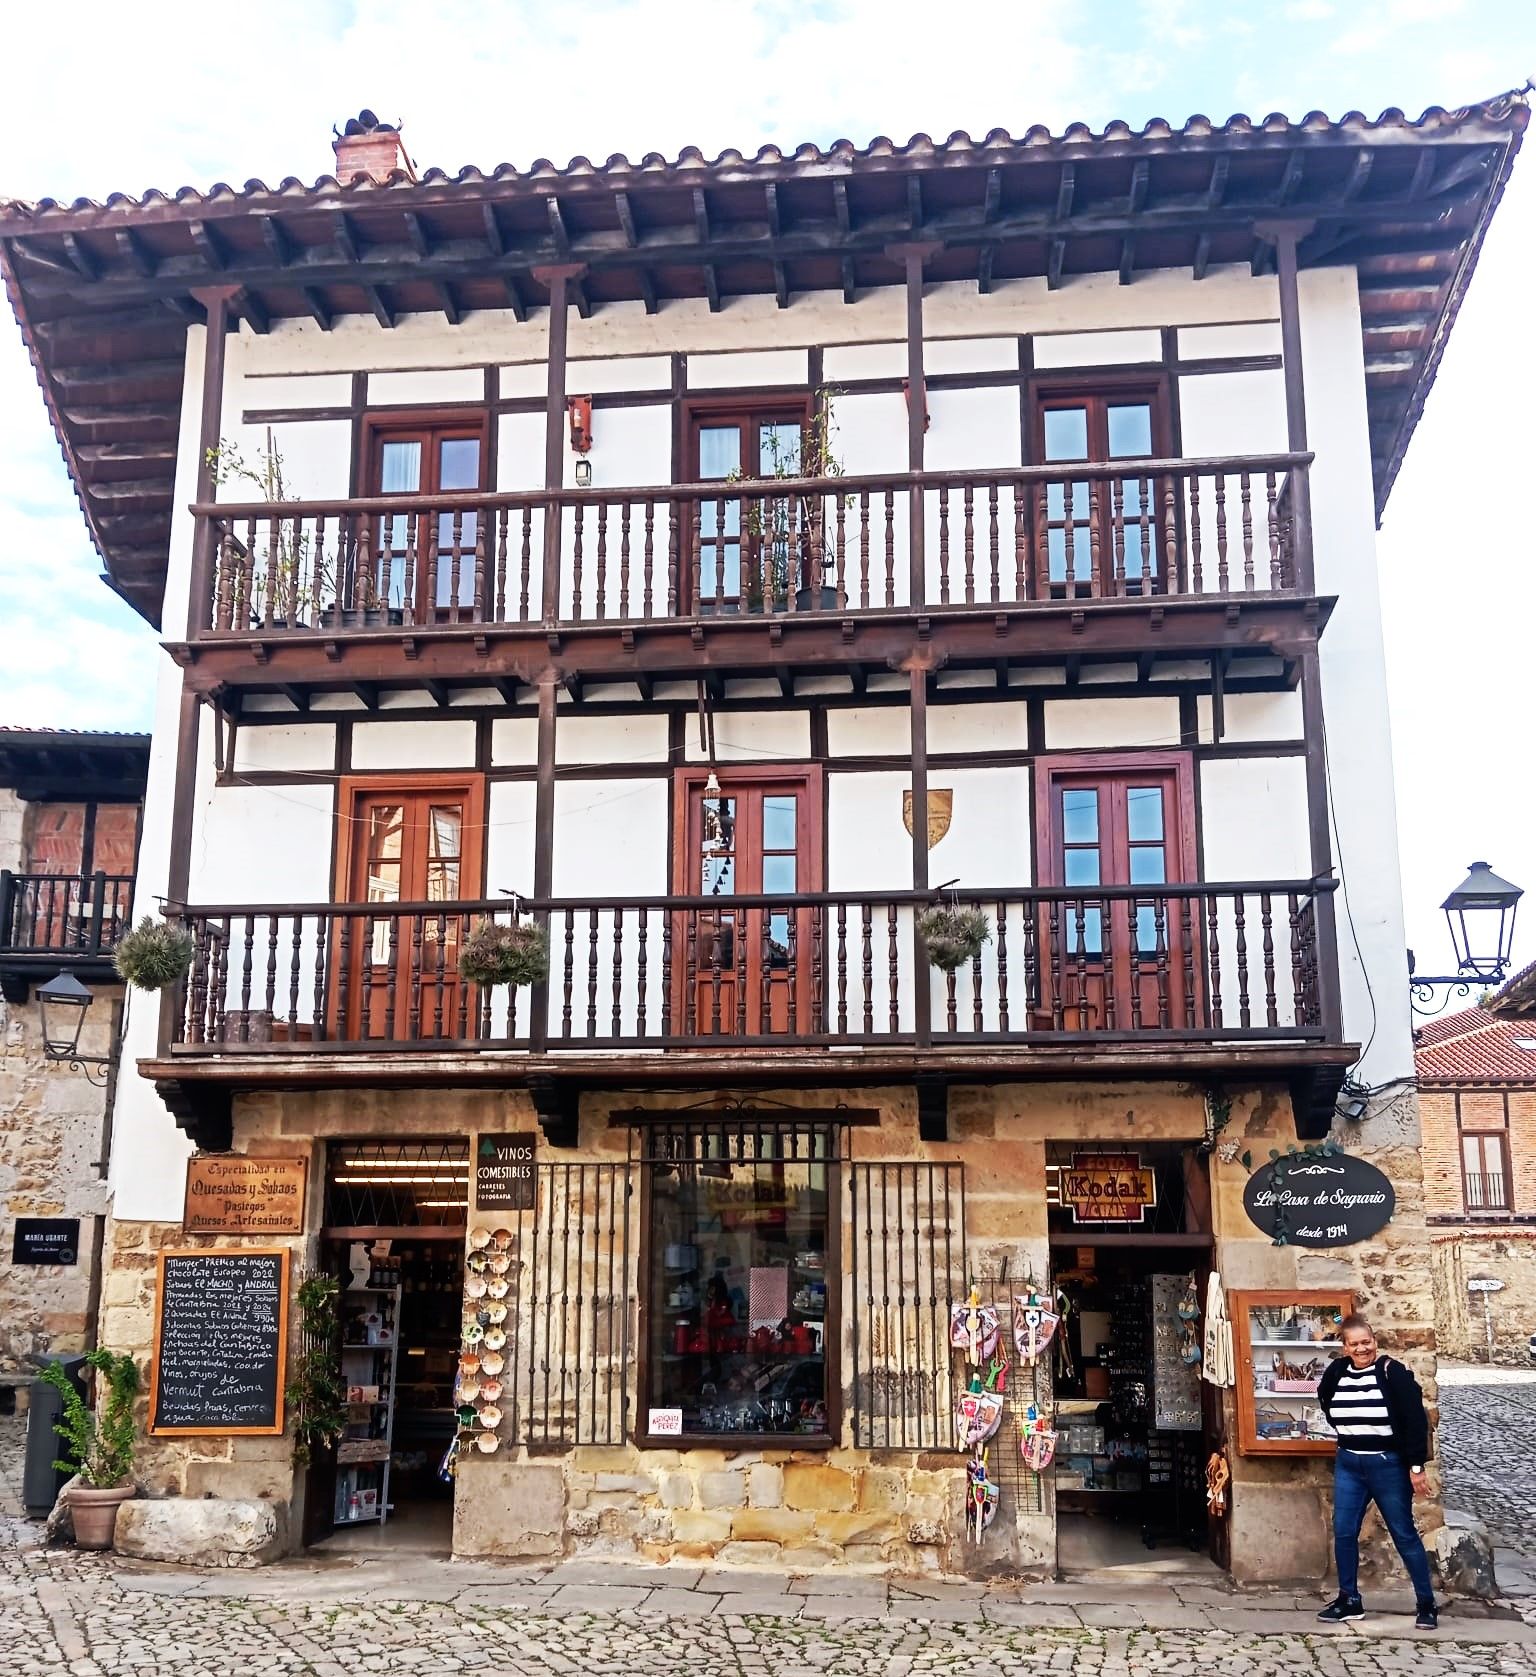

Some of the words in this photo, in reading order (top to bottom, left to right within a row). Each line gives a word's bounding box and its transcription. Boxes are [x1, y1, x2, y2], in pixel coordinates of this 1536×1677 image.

[496, 1147, 532, 1160] VINOS
[207, 1163, 270, 1176] Especialidad
[274, 1166, 286, 1174] en
[477, 1166, 531, 1179] COMESTIBLES
[191, 1179, 247, 1195] Quesadas
[249, 1184, 257, 1199] y
[257, 1178, 297, 1194] Sobaos
[1069, 1176, 1148, 1197] Kodak
[1253, 1190, 1274, 1207] La
[1279, 1190, 1310, 1206] Casa
[1313, 1190, 1329, 1206] de
[1329, 1188, 1386, 1209] Sagrario
[191, 1214, 227, 1226] Quesos
[230, 1214, 293, 1226] Artesanales
[1296, 1225, 1323, 1238] desde
[1326, 1223, 1348, 1238] 1914
[237, 1258, 248, 1266] al
[213, 1268, 246, 1279] Europeo
[194, 1278, 205, 1289] El
[237, 1283, 243, 1293] y
[244, 1280, 278, 1289] ANDRAL
[219, 1292, 252, 1303] mejores
[245, 1304, 251, 1312] y
[200, 1340, 216, 1348] del
[189, 1370, 218, 1380] orujos
[219, 1373, 240, 1385] de
[162, 1382, 205, 1398] Vermut
